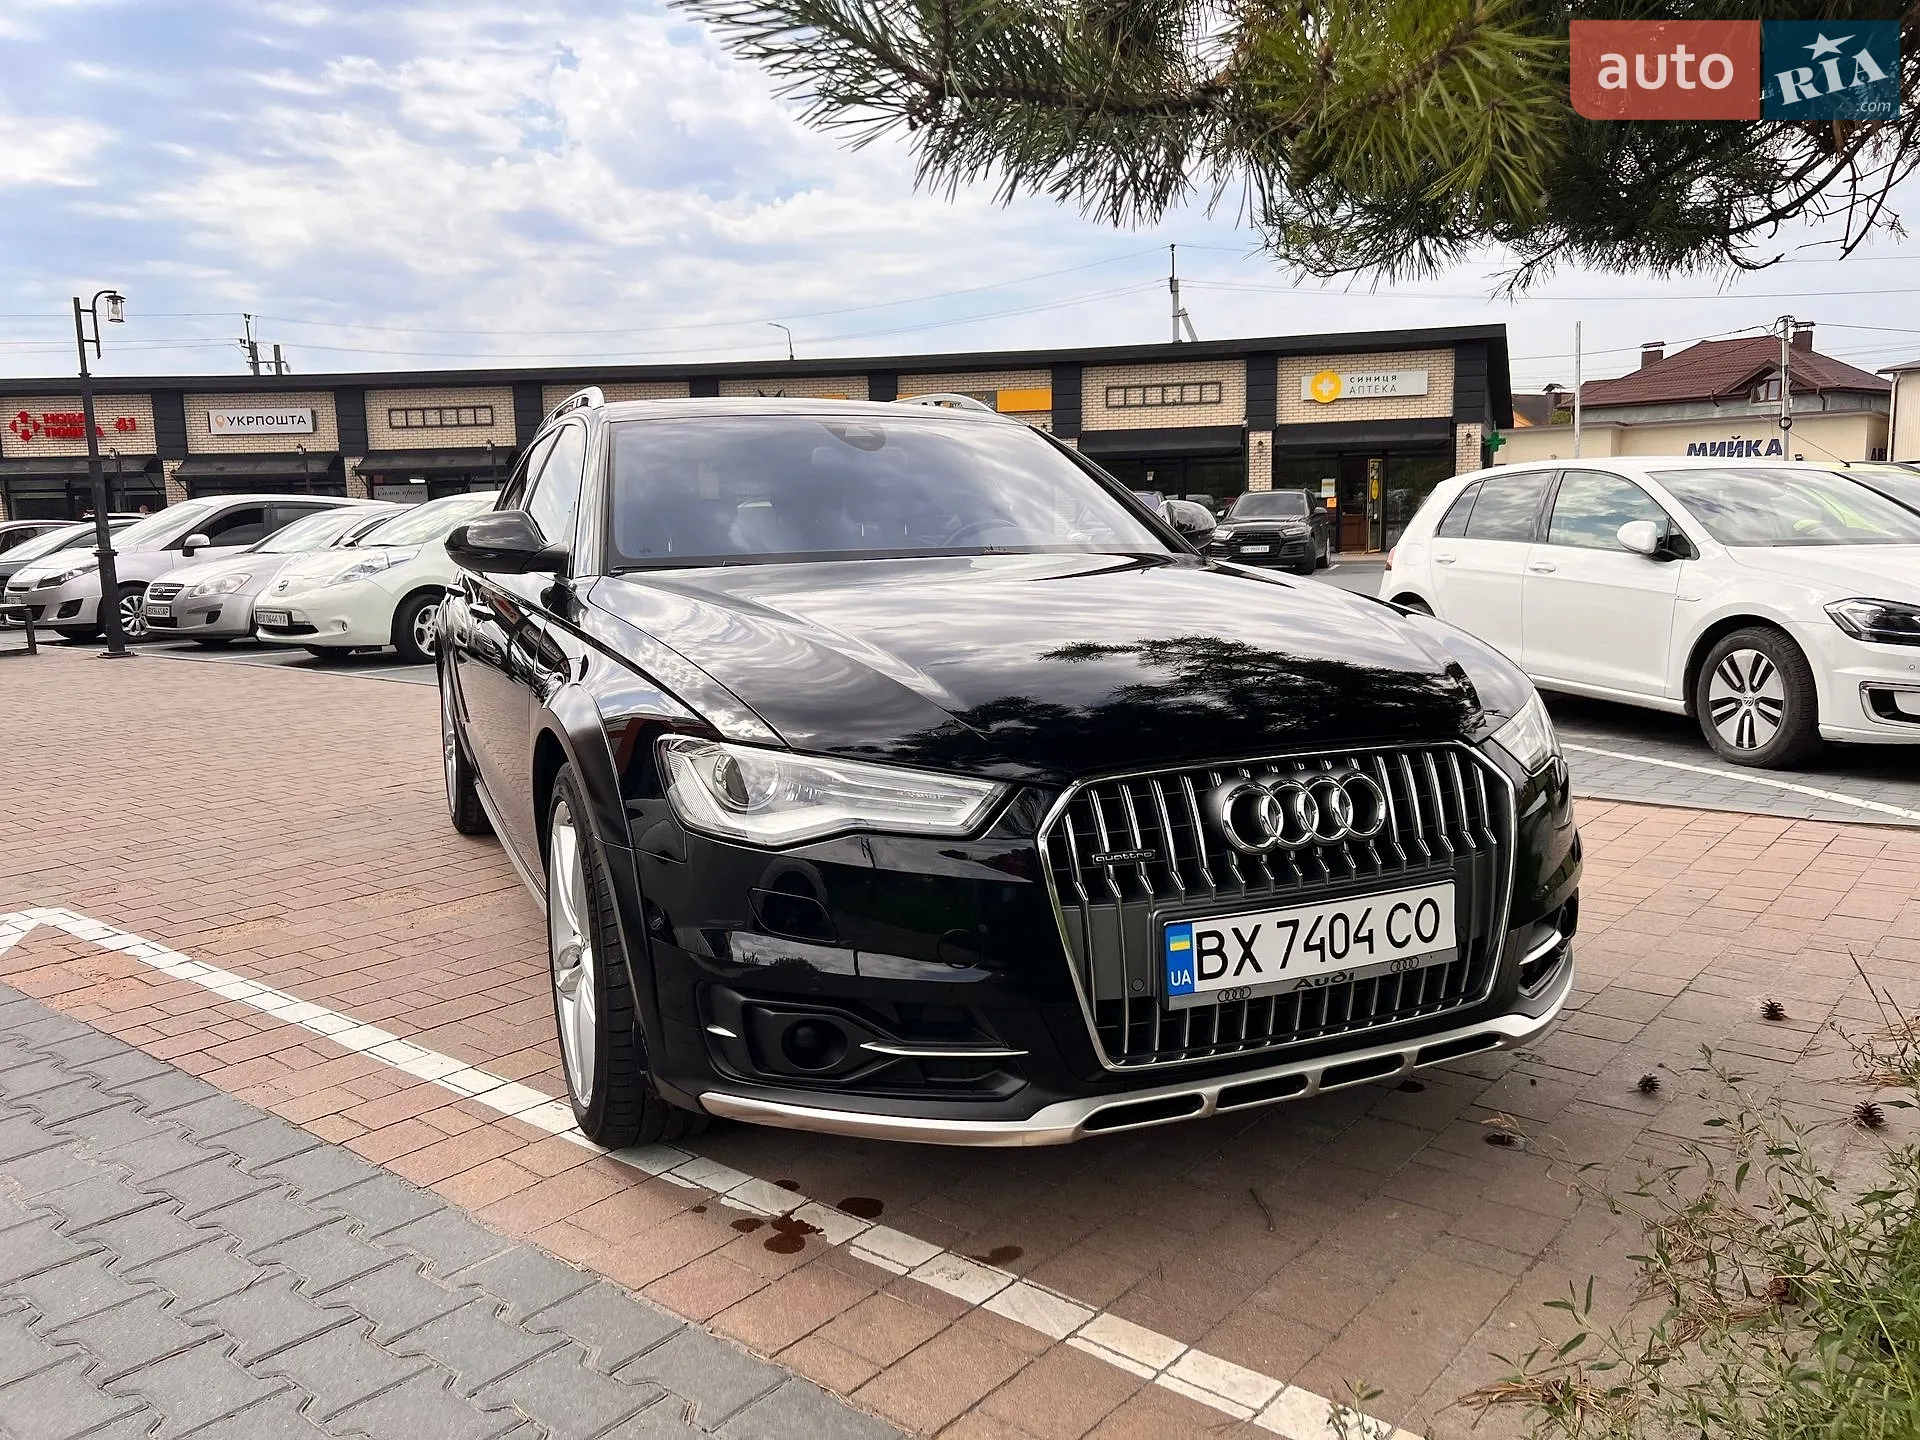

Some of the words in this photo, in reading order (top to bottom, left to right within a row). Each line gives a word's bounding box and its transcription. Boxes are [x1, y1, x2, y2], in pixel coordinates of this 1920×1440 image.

[1349, 385, 1397, 394] АПТЕКА
[227, 415, 307, 426] УКРПОШТА
[1687, 435, 1783, 458] МИЙКА
[1095, 852, 1153, 862] quattro
[1195, 923, 1263, 982] BX
[1276, 907, 1374, 970] 7404
[1385, 897, 1441, 949] CO
[1170, 969, 1192, 987] UA
[1292, 971, 1355, 991] Audi
